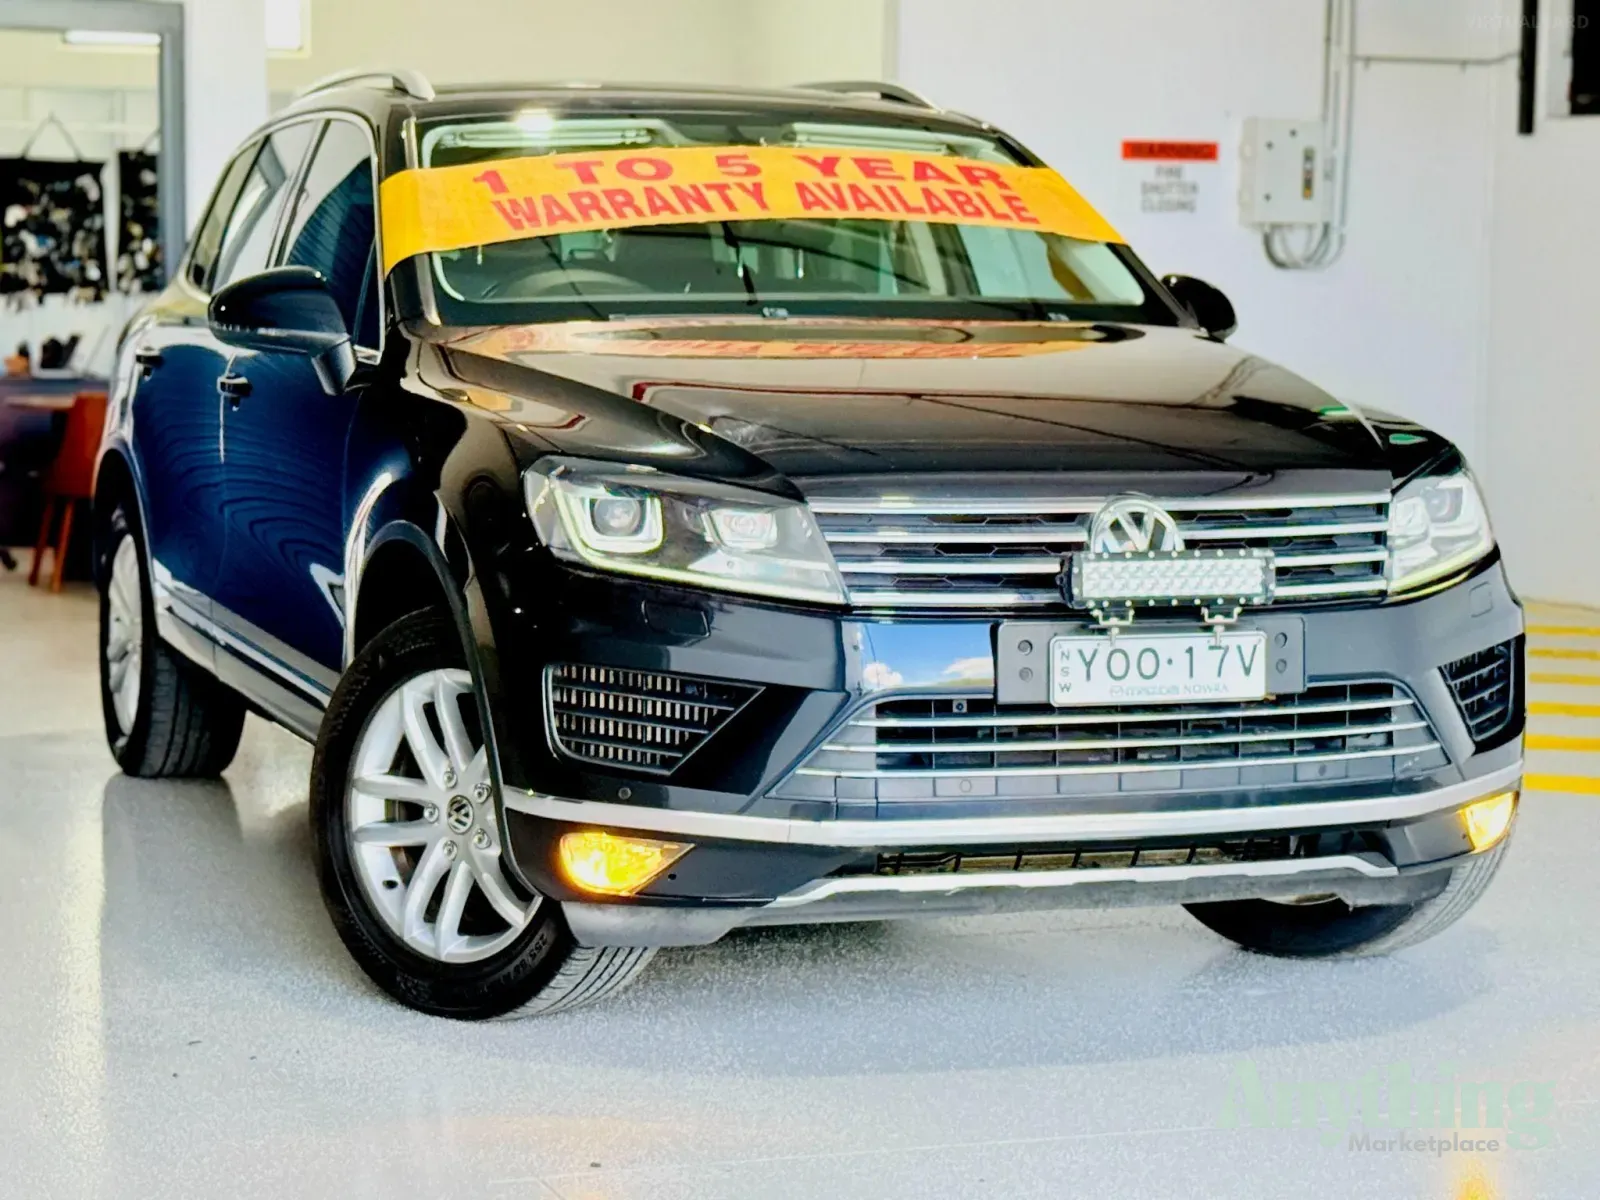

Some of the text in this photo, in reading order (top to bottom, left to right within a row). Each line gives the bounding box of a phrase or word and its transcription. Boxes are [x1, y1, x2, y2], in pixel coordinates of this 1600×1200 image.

[473, 154, 1013, 193] 1 TO 5 YEAR
[490, 181, 1040, 231] WARRANTY AVAILABLE
